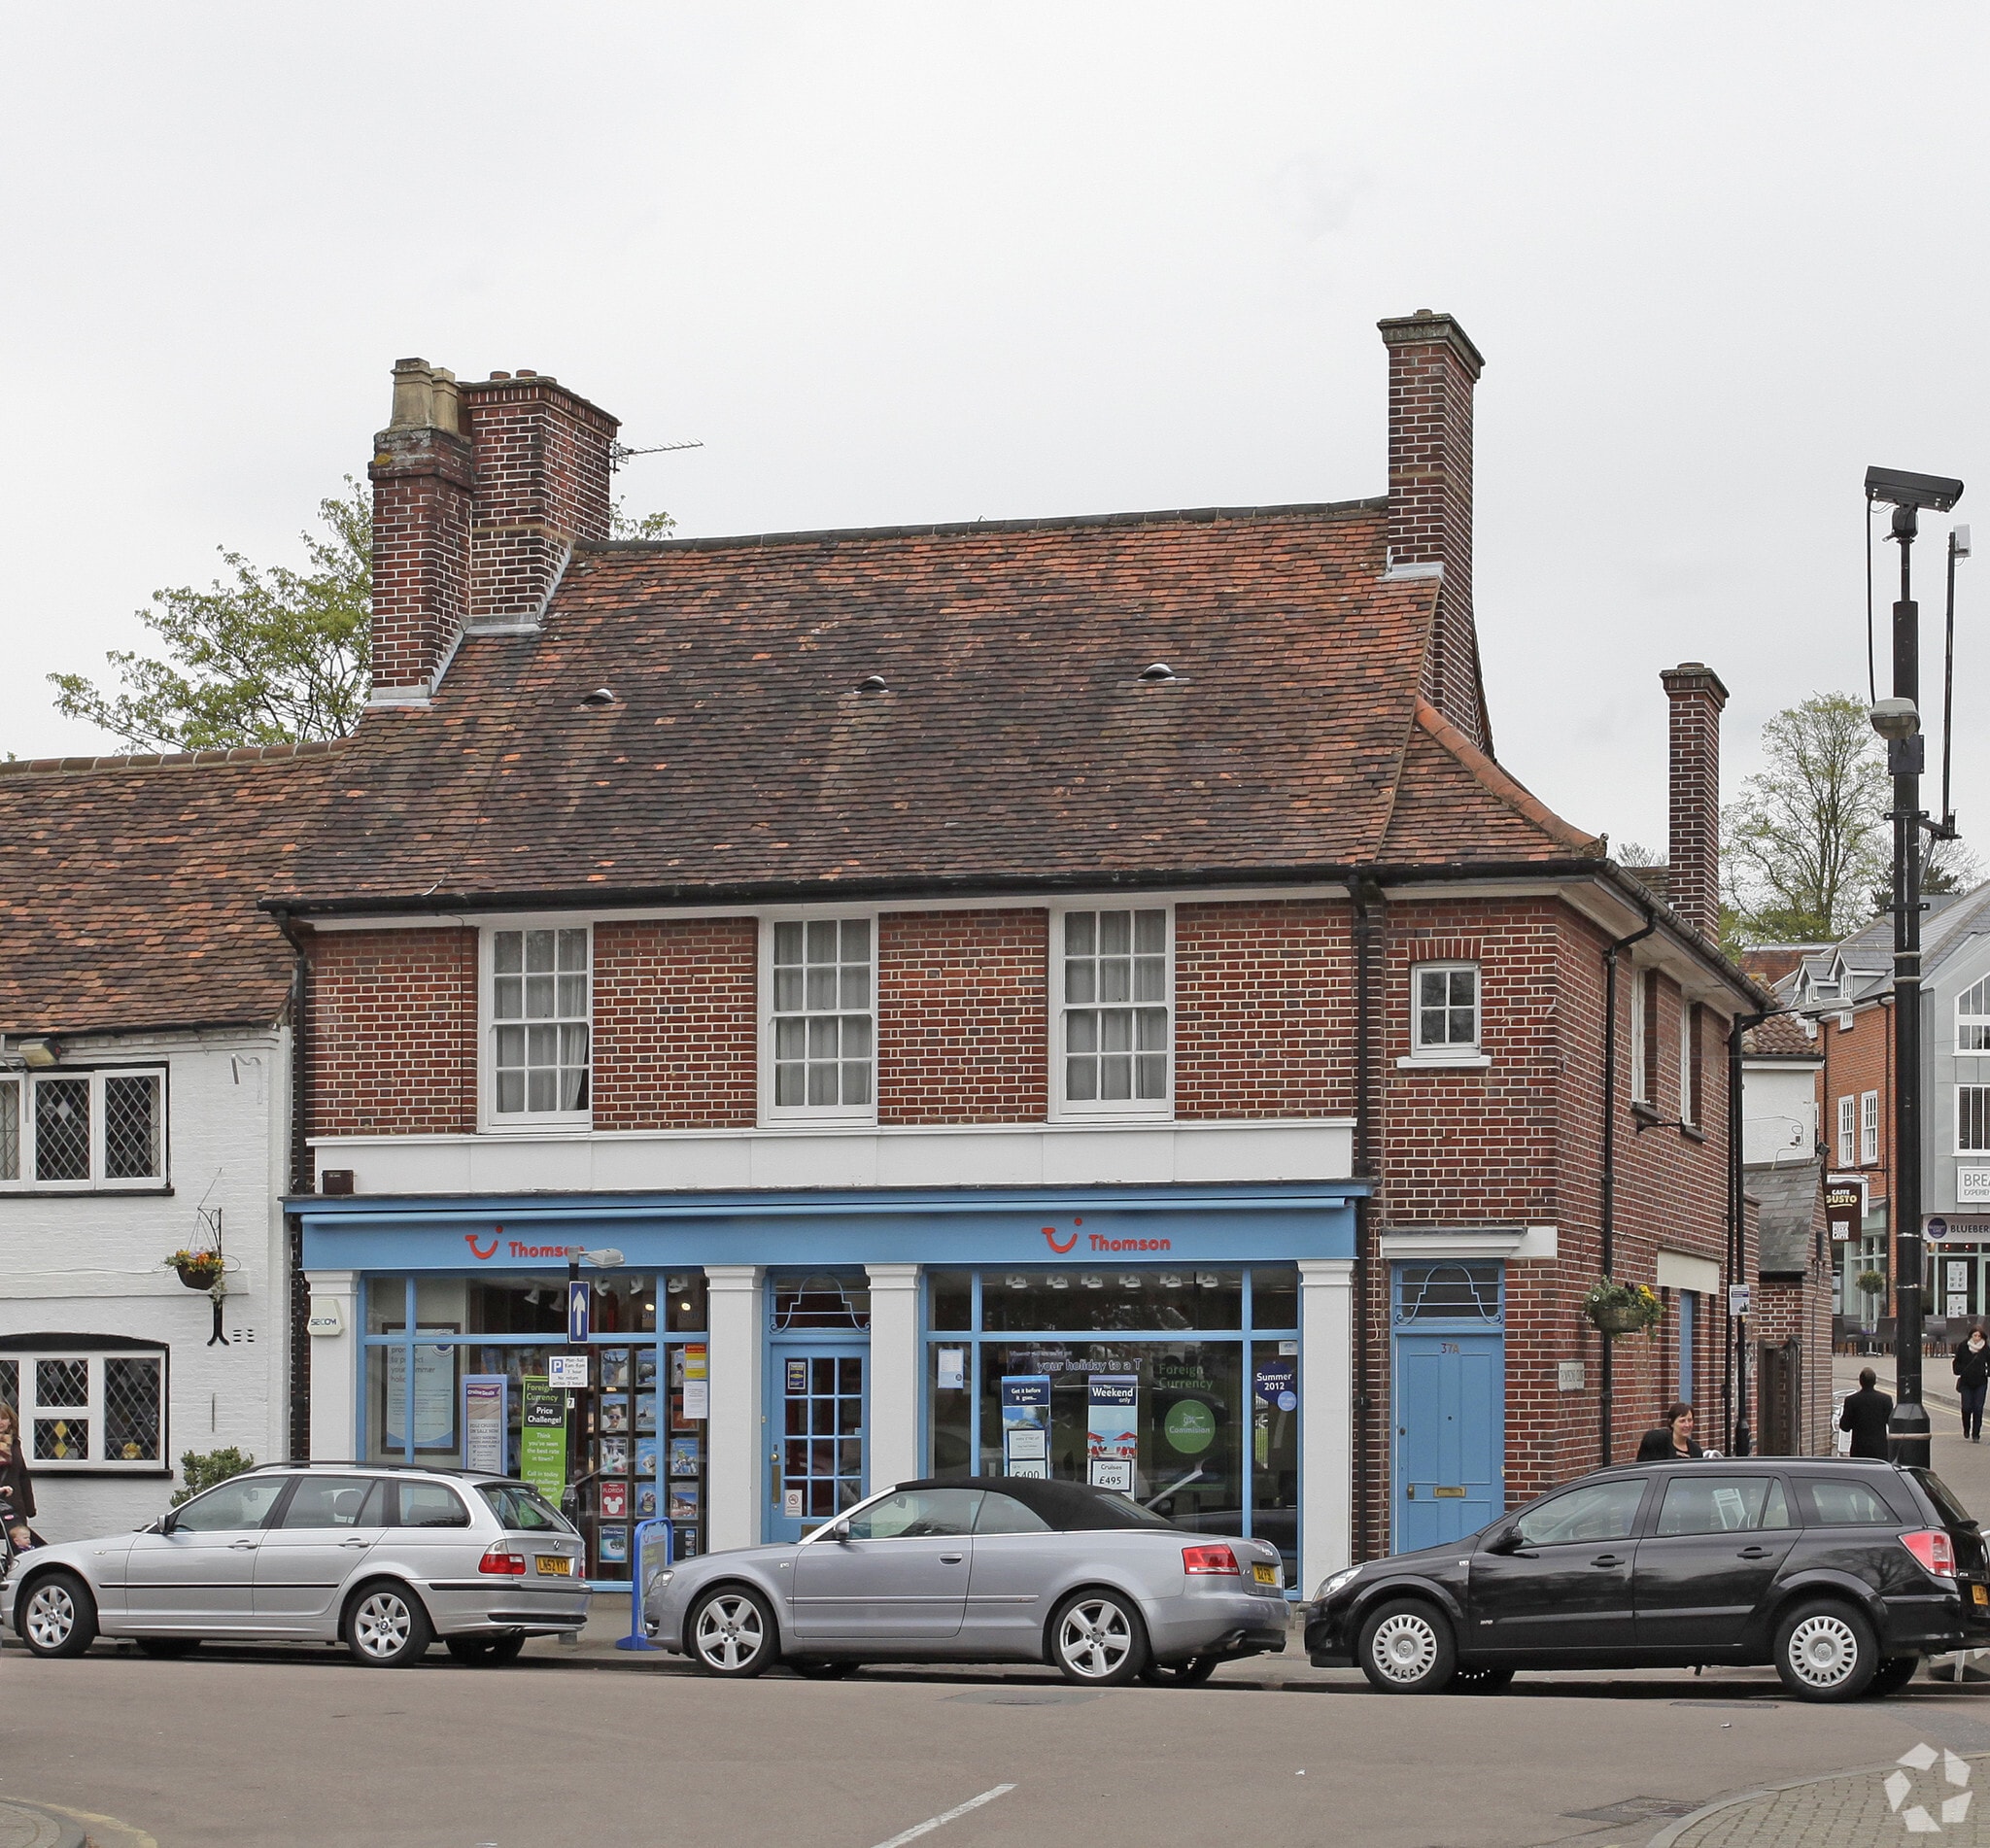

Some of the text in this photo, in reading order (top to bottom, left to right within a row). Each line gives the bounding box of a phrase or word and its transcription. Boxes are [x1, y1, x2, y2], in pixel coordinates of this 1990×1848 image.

[1964, 1174, 1990, 1186] BRE
[1088, 1234, 1171, 1251] Thomson
[508, 1241, 585, 1257] Thoms
[1441, 1343, 1460, 1353] 37A
[554, 1360, 563, 1373] P
[1037, 1361, 1064, 1374] your
[1065, 1358, 1107, 1373] holiday
[1109, 1359, 1121, 1371] to
[1133, 1358, 1143, 1371] T
[1159, 1363, 1204, 1377] Foreign
[1256, 1372, 1292, 1381] Summer
[1159, 1377, 1214, 1390] Currency
[1264, 1382, 1285, 1390] 2012
[527, 1392, 559, 1402] Currency
[1091, 1387, 1133, 1397] Weekend
[536, 1406, 554, 1415] Price
[528, 1415, 562, 1424] Challenge!
[1099, 1476, 1122, 1485] £495
